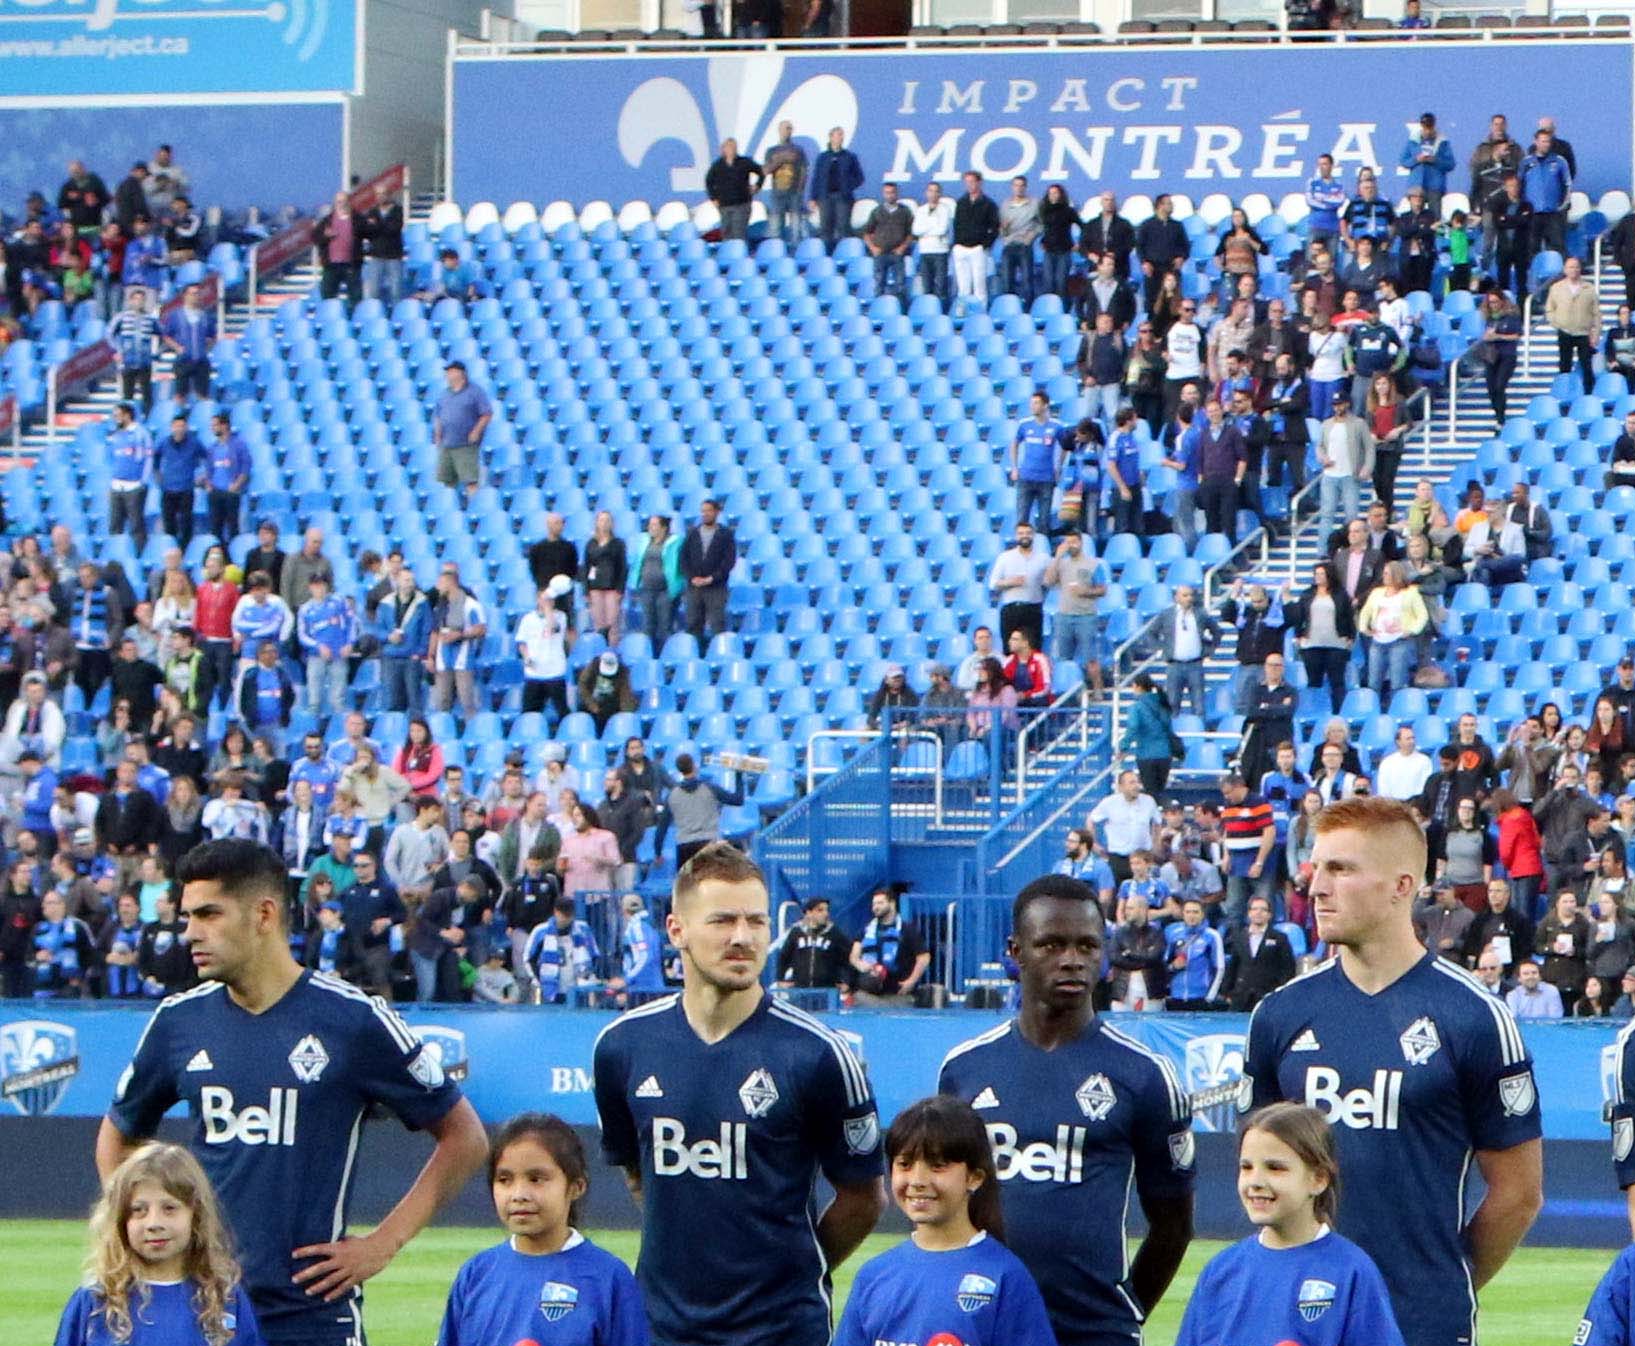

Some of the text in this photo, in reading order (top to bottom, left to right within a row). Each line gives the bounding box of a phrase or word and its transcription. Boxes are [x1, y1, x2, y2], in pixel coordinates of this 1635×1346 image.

[897, 76, 1199, 115] IMPACT
[201, 1086, 299, 1146] Bell
[1304, 1066, 1404, 1130] Bell
[652, 1117, 748, 1179] Bell
[985, 1123, 1088, 1183] Bell
